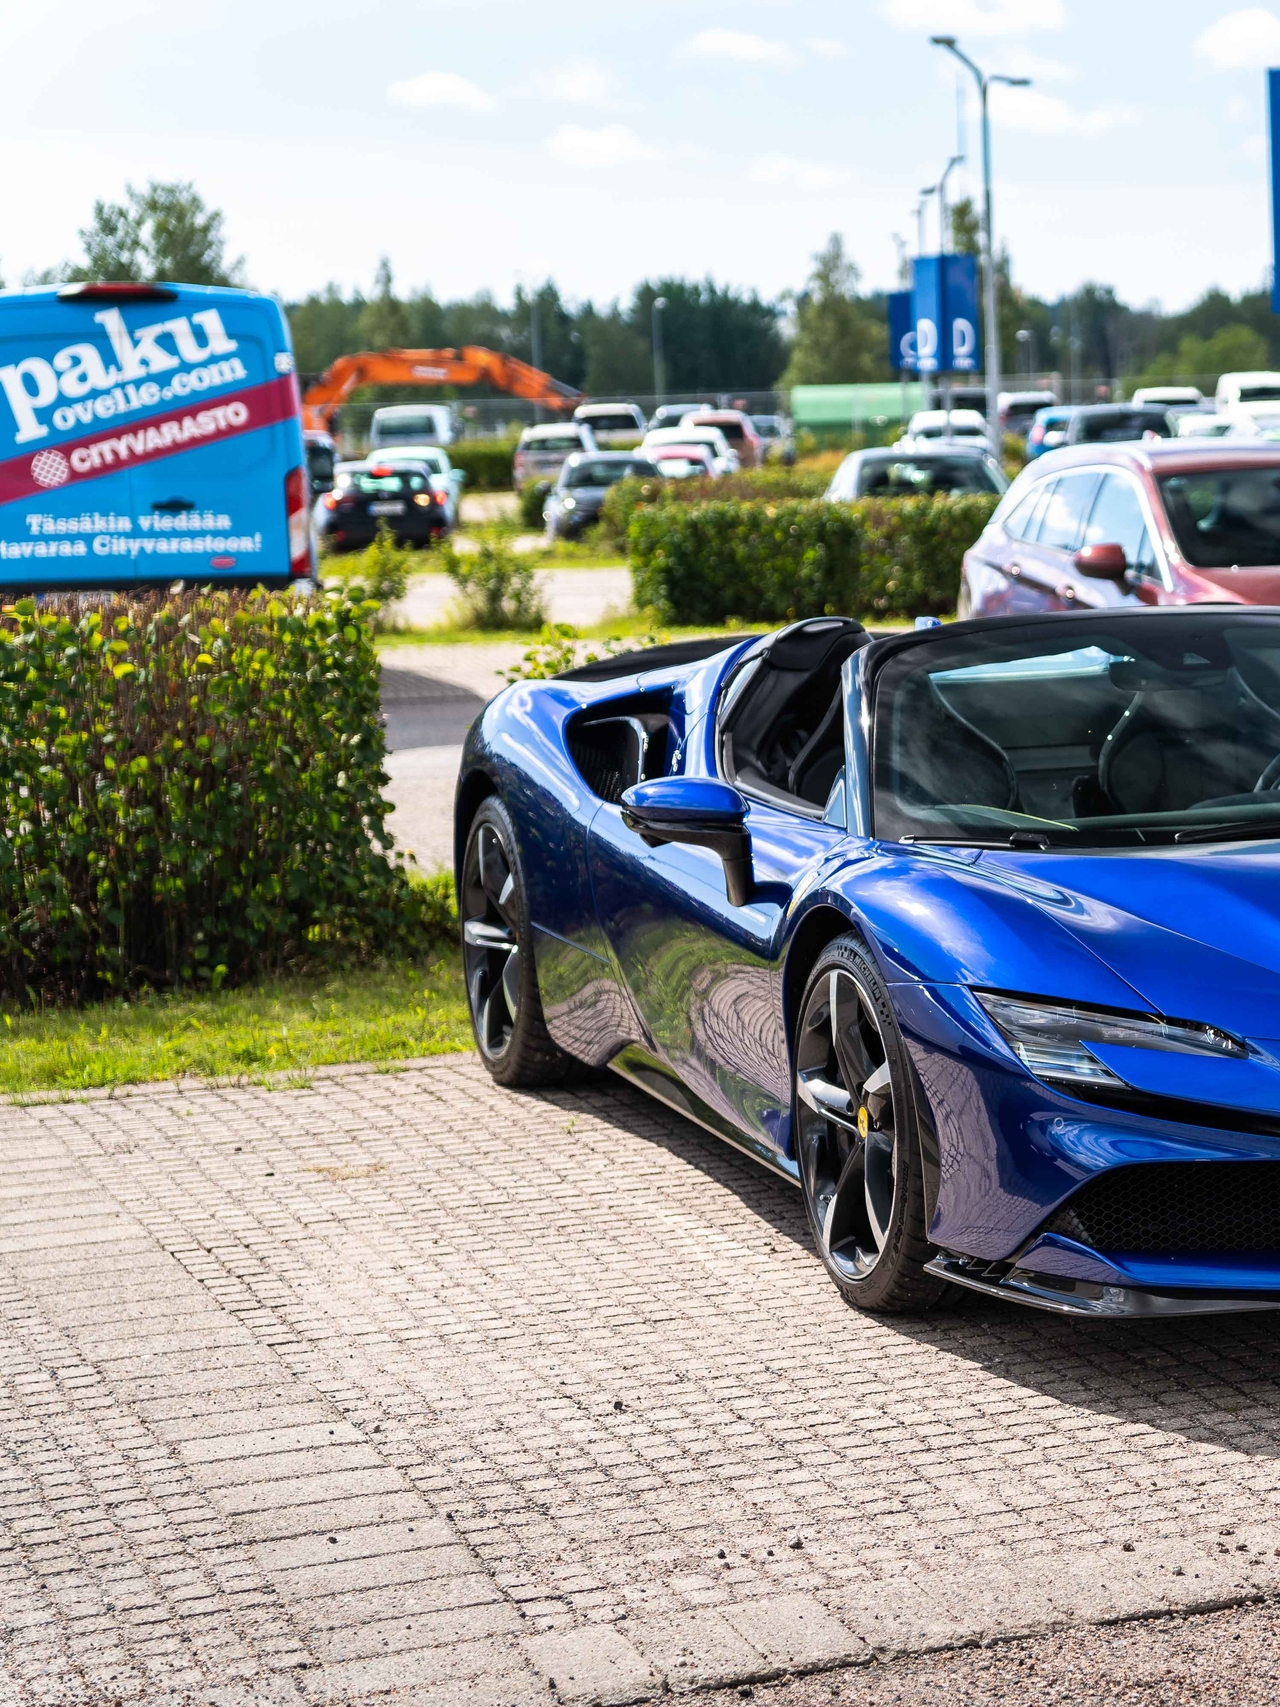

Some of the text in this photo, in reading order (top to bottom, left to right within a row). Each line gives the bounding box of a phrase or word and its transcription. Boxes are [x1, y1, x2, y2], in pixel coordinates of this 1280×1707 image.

[916, 318, 938, 357] D
[952, 317, 976, 357] D
[0, 307, 239, 444] paku
[52, 357, 248, 431] ovelle.com
[70, 401, 249, 473] CITYVARASTO
[26, 512, 132, 535] Tässäkin
[854, 956, 880, 1001] MICHELIN
